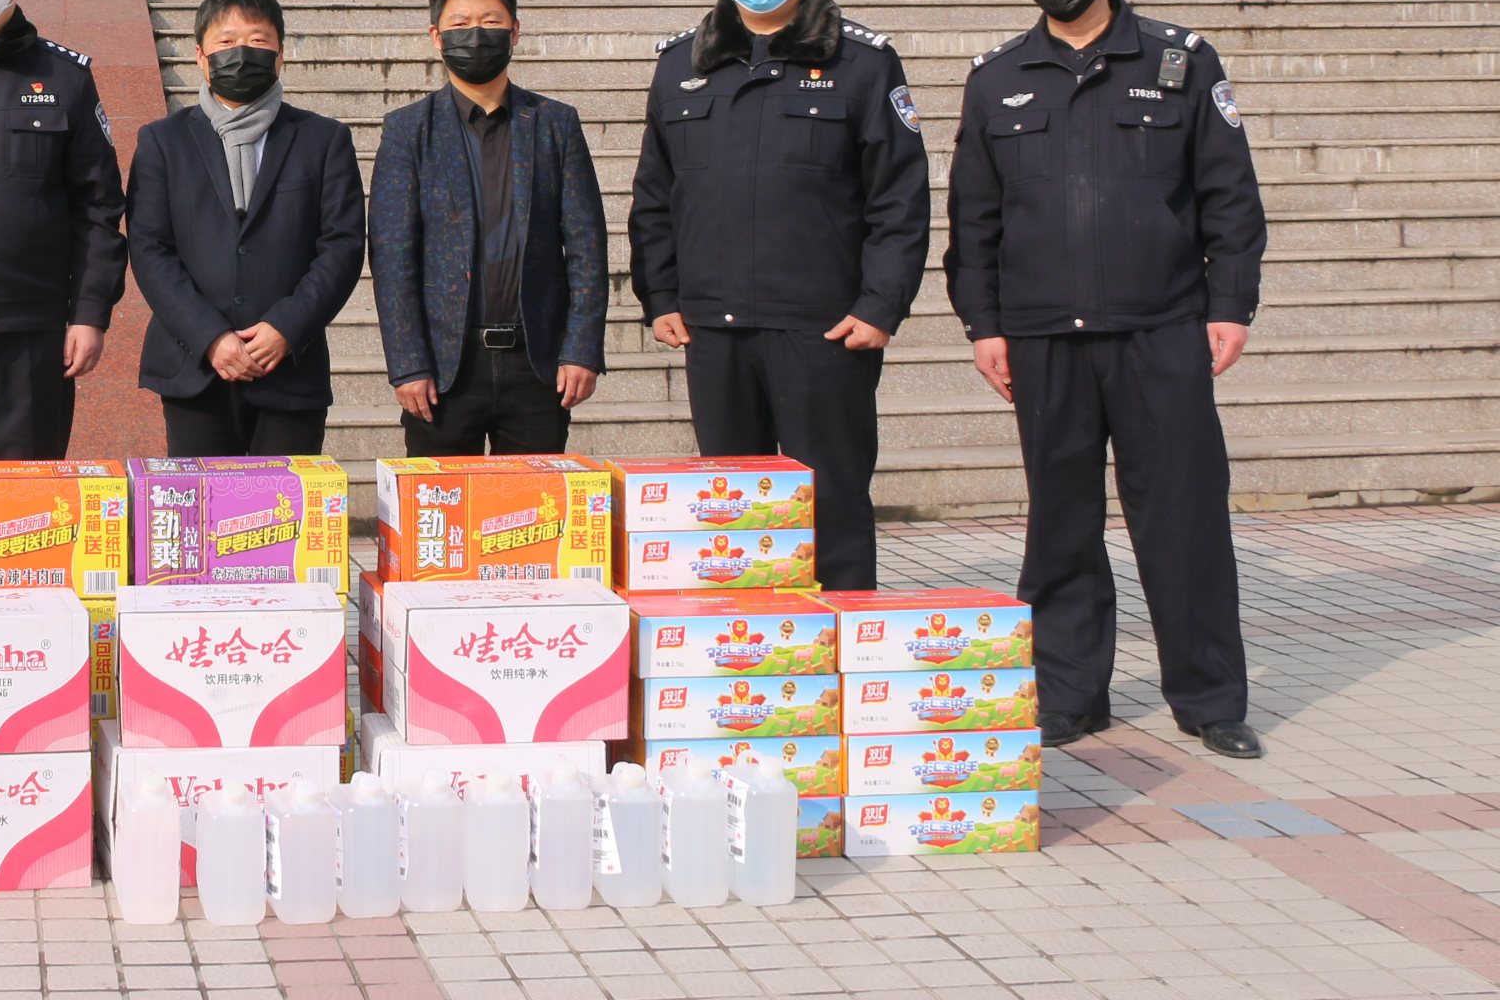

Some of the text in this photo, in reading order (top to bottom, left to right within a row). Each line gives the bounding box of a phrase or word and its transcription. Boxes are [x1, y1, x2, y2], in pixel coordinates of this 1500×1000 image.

[799, 80, 834, 89] 175616
[21, 94, 55, 103] 072928
[1129, 88, 1163, 99] 176251
[644, 483, 666, 499] 双汇
[687, 499, 752, 514] 双汇王中王
[85, 494, 102, 555] 箱箱送
[307, 490, 324, 551] 箱箱送
[570, 489, 588, 549] 箱箱送
[151, 509, 182, 570] 劲爽
[417, 508, 446, 569] 劲爽
[183, 526, 199, 570] 拉面
[448, 525, 464, 569] 拉面
[646, 541, 667, 557] 双汇
[478, 563, 551, 581] 香辣牛肉面
[688, 557, 753, 572] 双汇王中王
[212, 565, 289, 581] 老坛酸菜牛肉面
[660, 628, 682, 643] 双汇
[861, 623, 880, 637] 双汇
[165, 625, 303, 669] 娃哈哈
[453, 621, 589, 663] 娃哈哈
[904, 637, 971, 652] 双汇王中王
[705, 643, 773, 659] 双汇王中王
[204, 673, 264, 685] 饮用纯净水
[490, 668, 549, 680] 饮用纯净水
[662, 689, 684, 704] 双汇
[865, 683, 885, 698] 双汇
[707, 704, 775, 719] 双汇王中王
[908, 697, 975, 712] 双汇王中王
[868, 747, 888, 762] 双汇
[912, 761, 979, 776] 双汇王中王
[864, 807, 885, 821] 双汇
[908, 820, 975, 835] 双汇王中王
